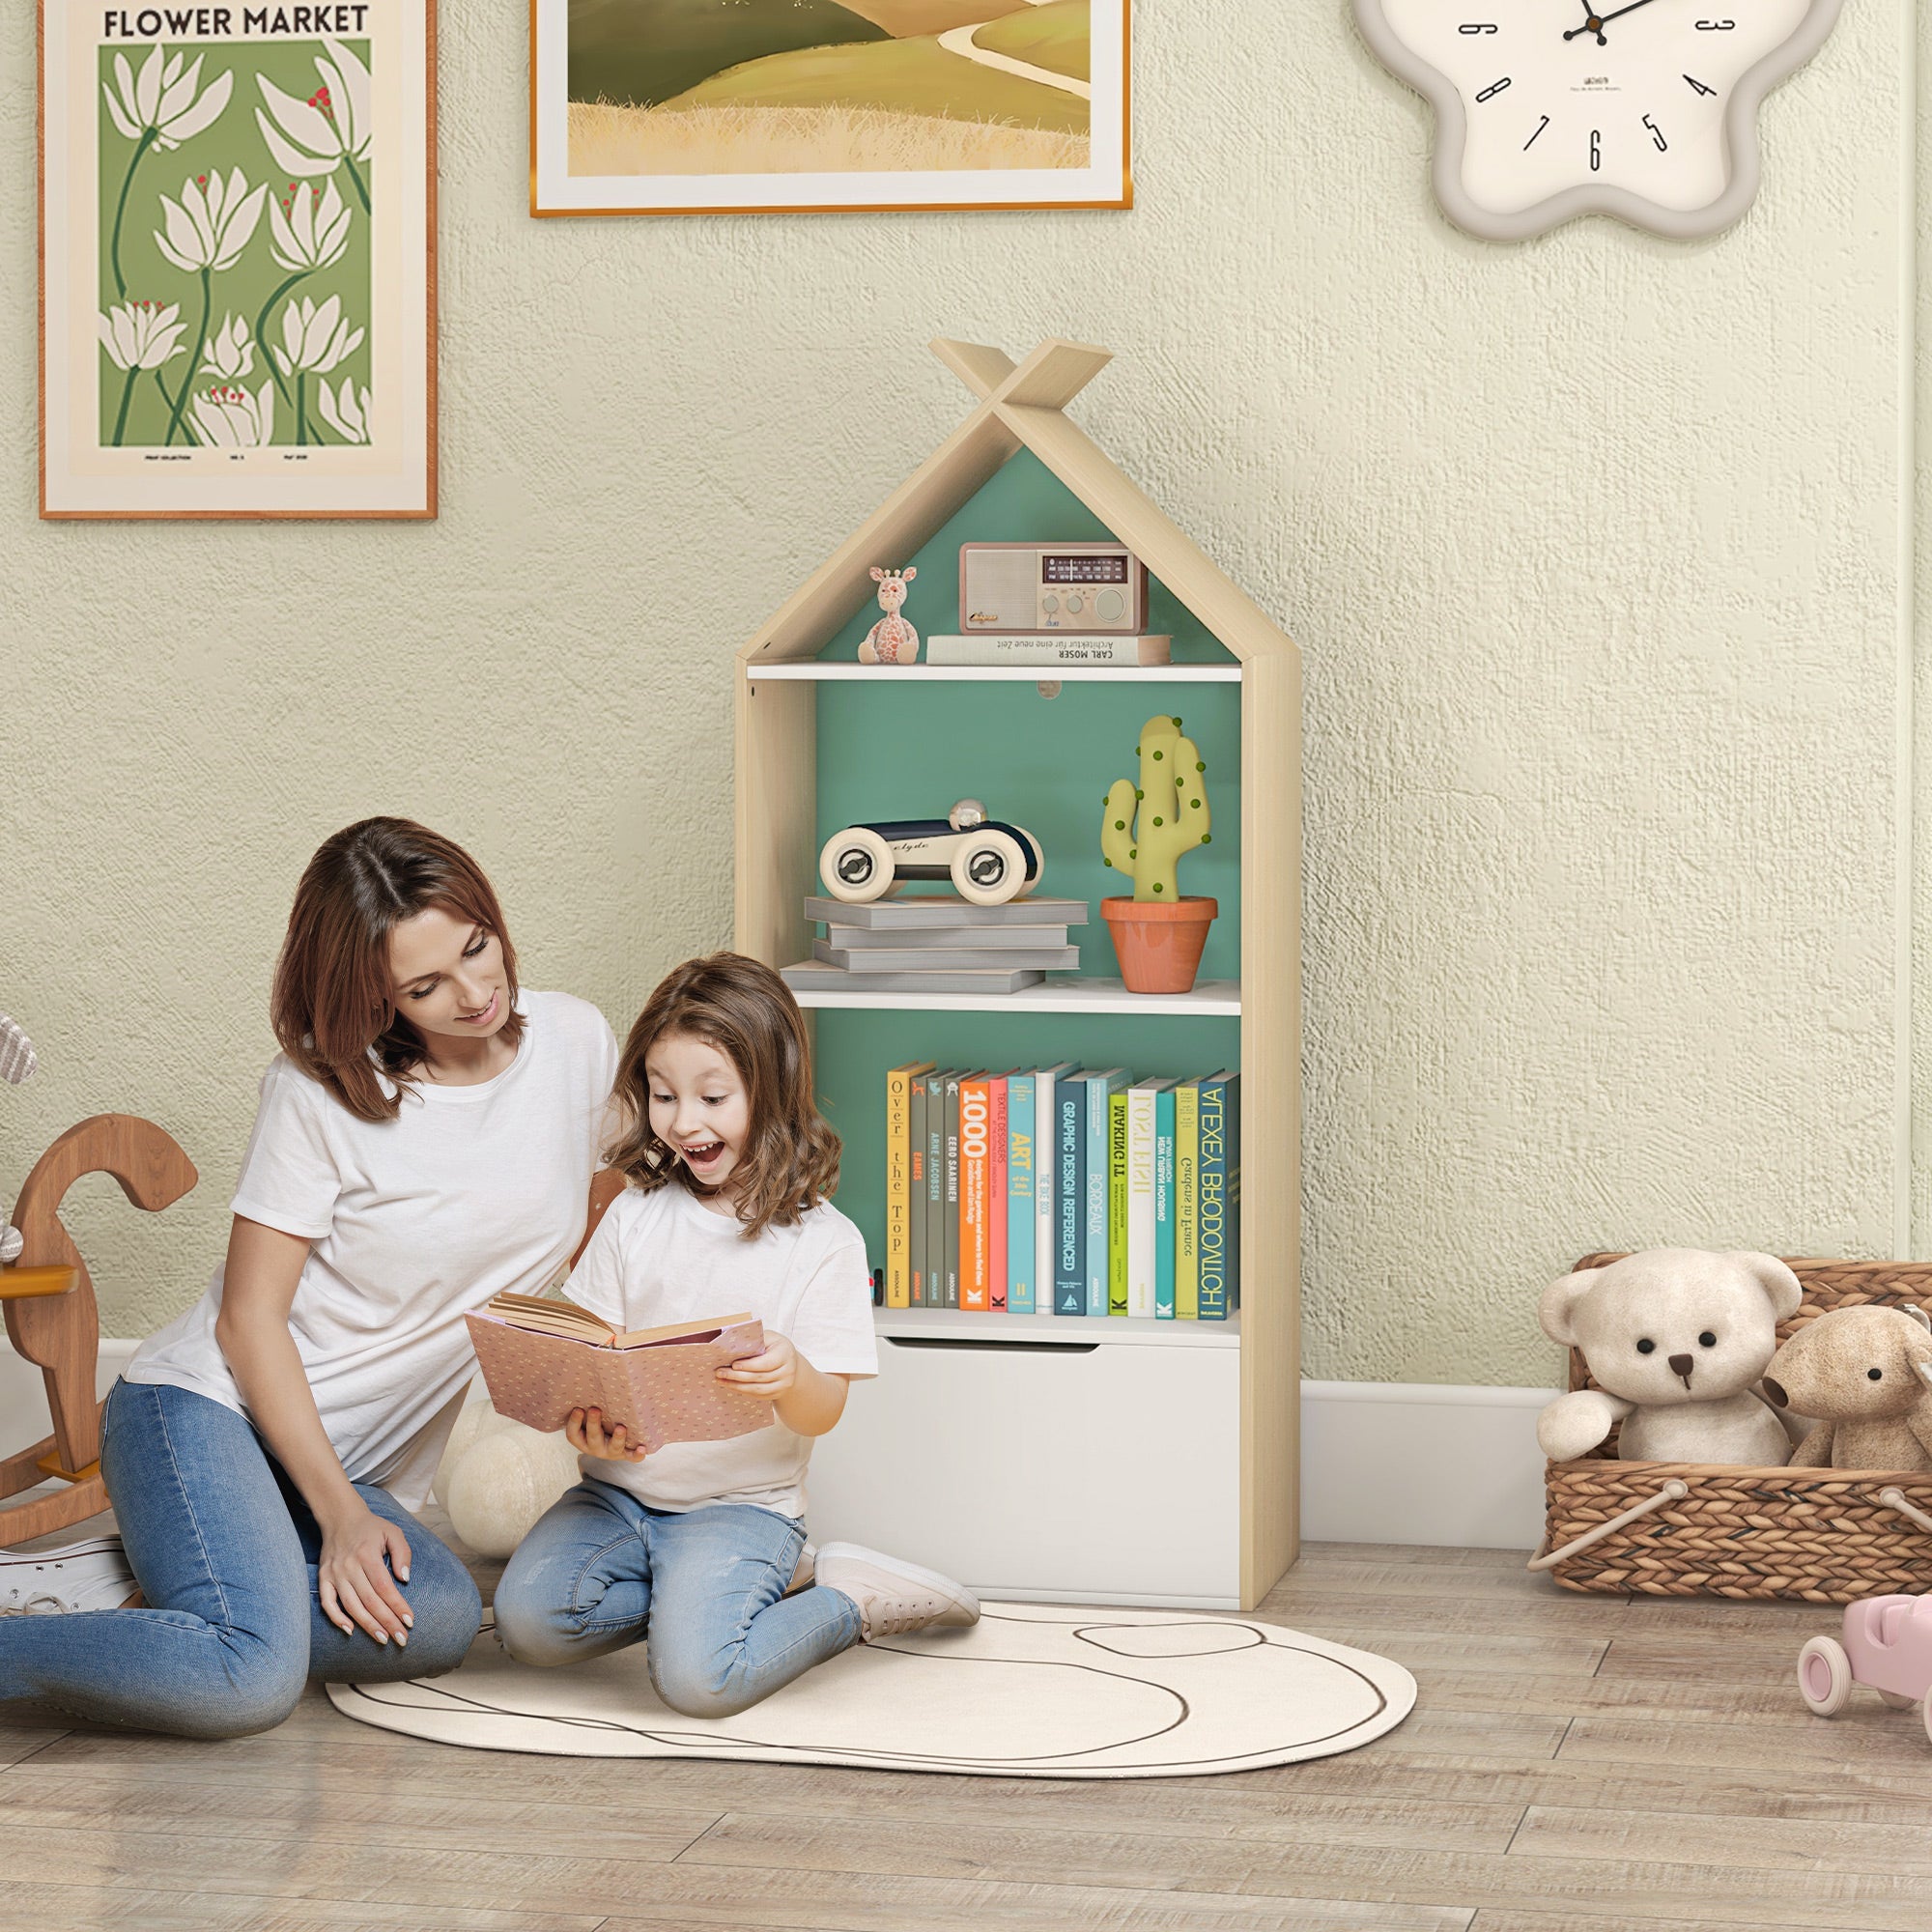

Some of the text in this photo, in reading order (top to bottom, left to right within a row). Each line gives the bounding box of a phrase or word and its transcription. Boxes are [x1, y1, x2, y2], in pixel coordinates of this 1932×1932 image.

[104, 5, 369, 37] FLOWER MARKET
[1459, 23, 1498, 35] 9
[1695, 19, 1735, 31] 3
[1476, 77, 1512, 103] 8
[1683, 73, 1718, 97] 4
[1523, 115, 1550, 152] 7
[1590, 129, 1601, 172] 6
[1642, 114, 1668, 152] 5
[997, 640, 1012, 649] Zeit
[1059, 650, 1113, 659] CARL MOSER
[1068, 640, 1113, 650] Architektur
[893, 841, 929, 852] clyde
[892, 1080, 903, 1136] Over
[963, 1090, 987, 1158] 1000
[1063, 1101, 1075, 1152] GRAPHIC
[997, 1093, 1006, 1164] TEXTILE DESIGNERS
[912, 1151, 923, 1180] EAMES
[930, 1132, 940, 1201] ARNE JACOBSEN
[948, 1136, 957, 1203] EERO SAARINEN
[1011, 1131, 1031, 1171] ART
[893, 1151, 902, 1192] the
[1063, 1154, 1075, 1196] DESIGN
[1090, 1174, 1102, 1236] BORDEAUX
[892, 1205, 903, 1253] Top
[1063, 1198, 1075, 1271] REFERENCED
